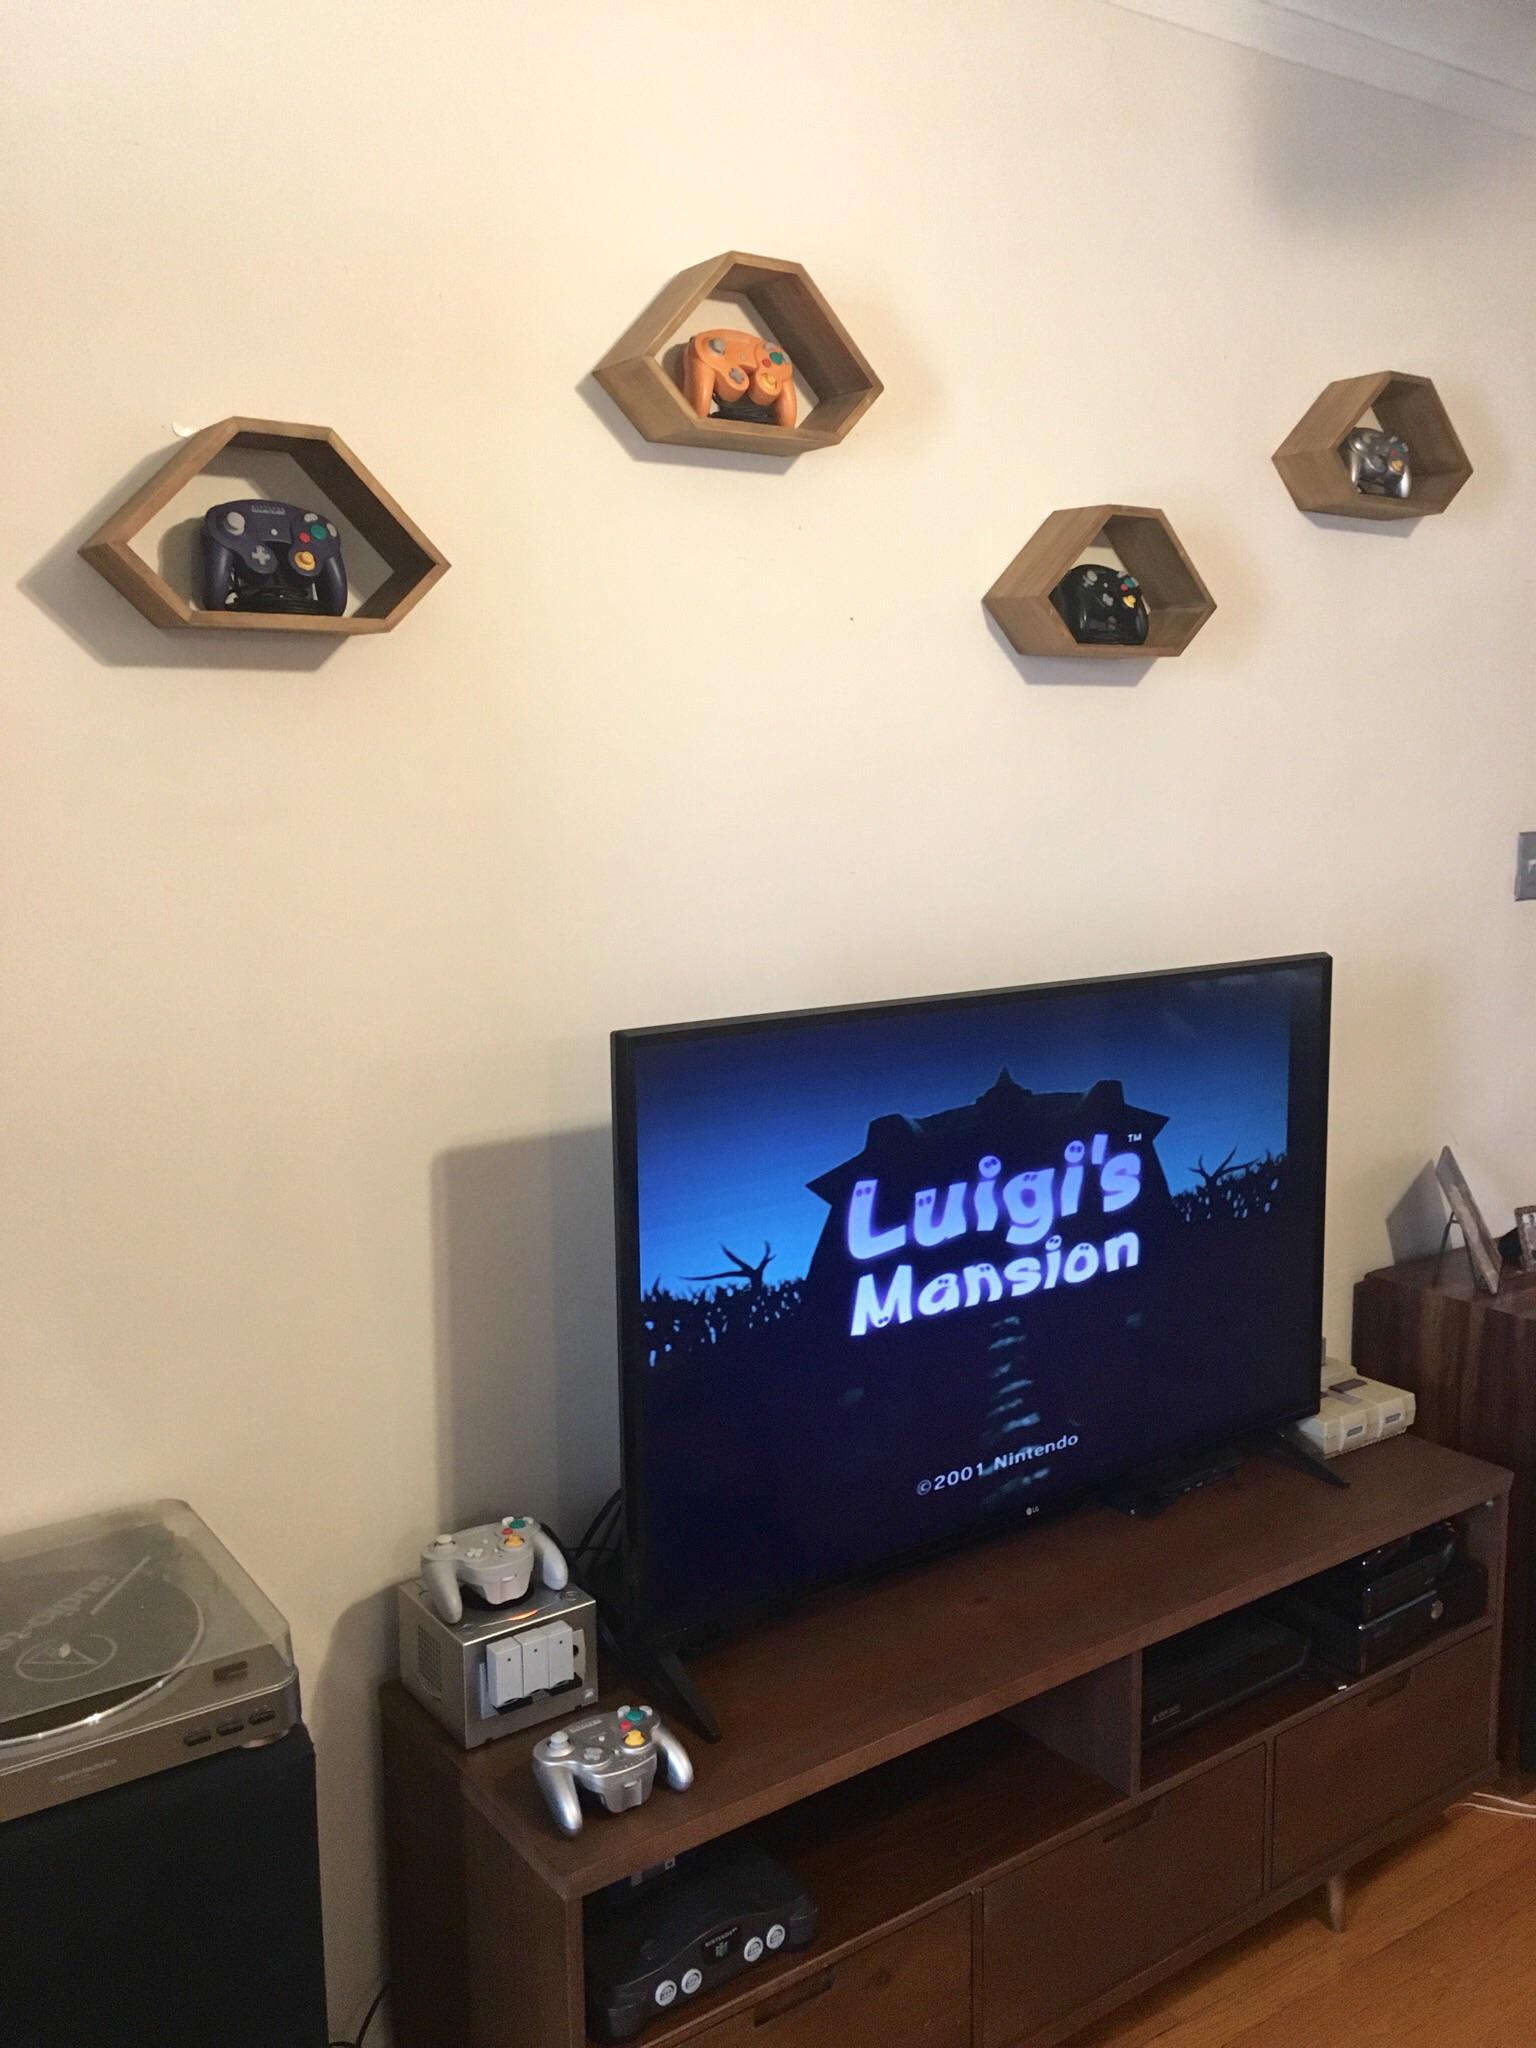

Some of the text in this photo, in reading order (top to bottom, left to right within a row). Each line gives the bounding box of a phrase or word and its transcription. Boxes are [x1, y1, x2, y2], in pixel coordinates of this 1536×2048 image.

[848, 1133, 1142, 1260] Luigi's
[850, 1231, 1140, 1336] Mansion
[916, 1433, 1079, 1496] ©2001 Nintendo
